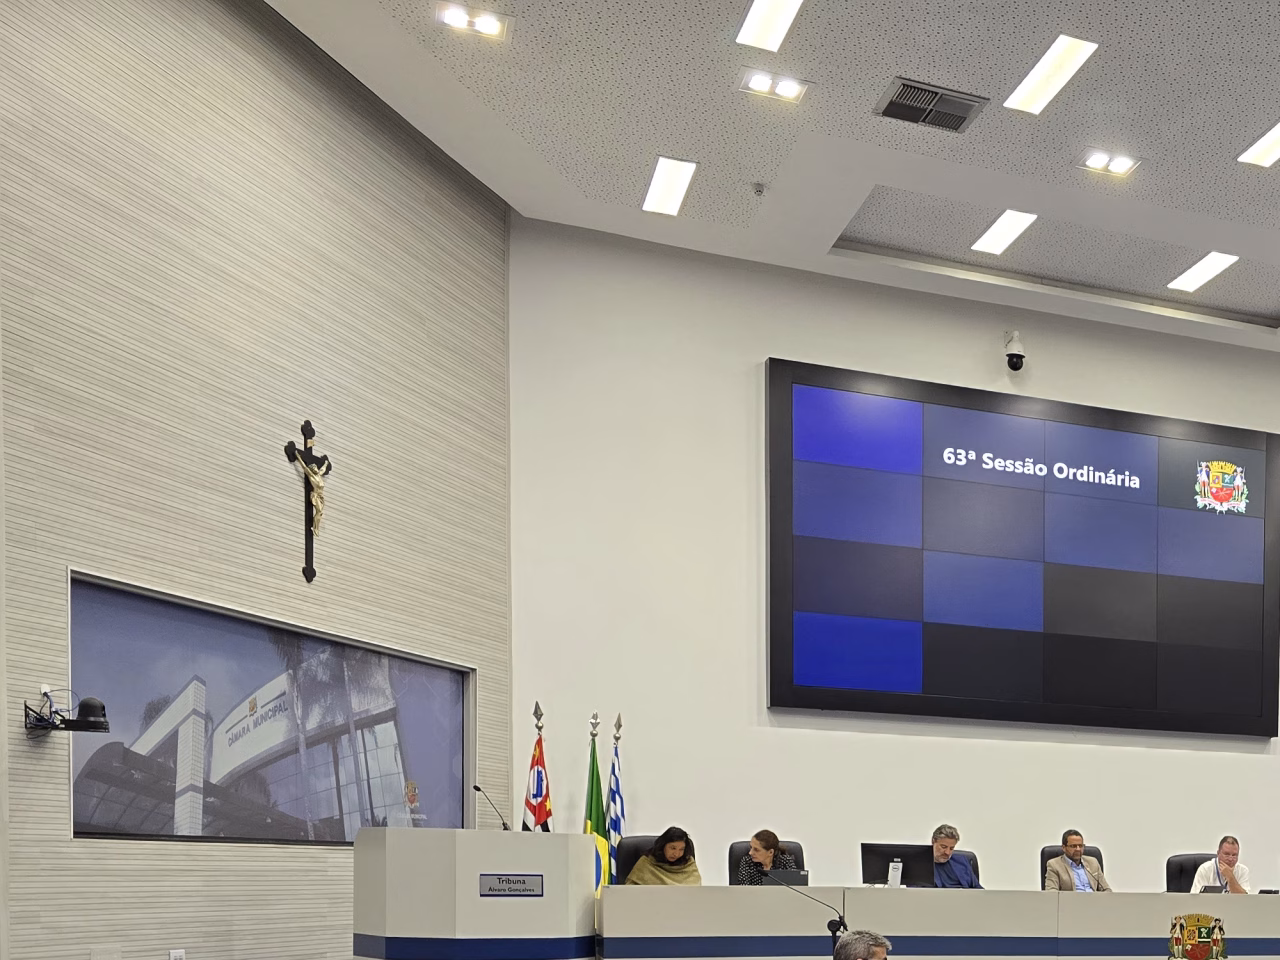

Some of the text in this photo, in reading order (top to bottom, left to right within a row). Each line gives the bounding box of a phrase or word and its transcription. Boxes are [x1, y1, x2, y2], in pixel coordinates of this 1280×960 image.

[943, 447, 1140, 489] 63ª Sessão Ordinária
[253, 701, 288, 730] MUNICIPAL
[497, 877, 526, 885] Tribuna
